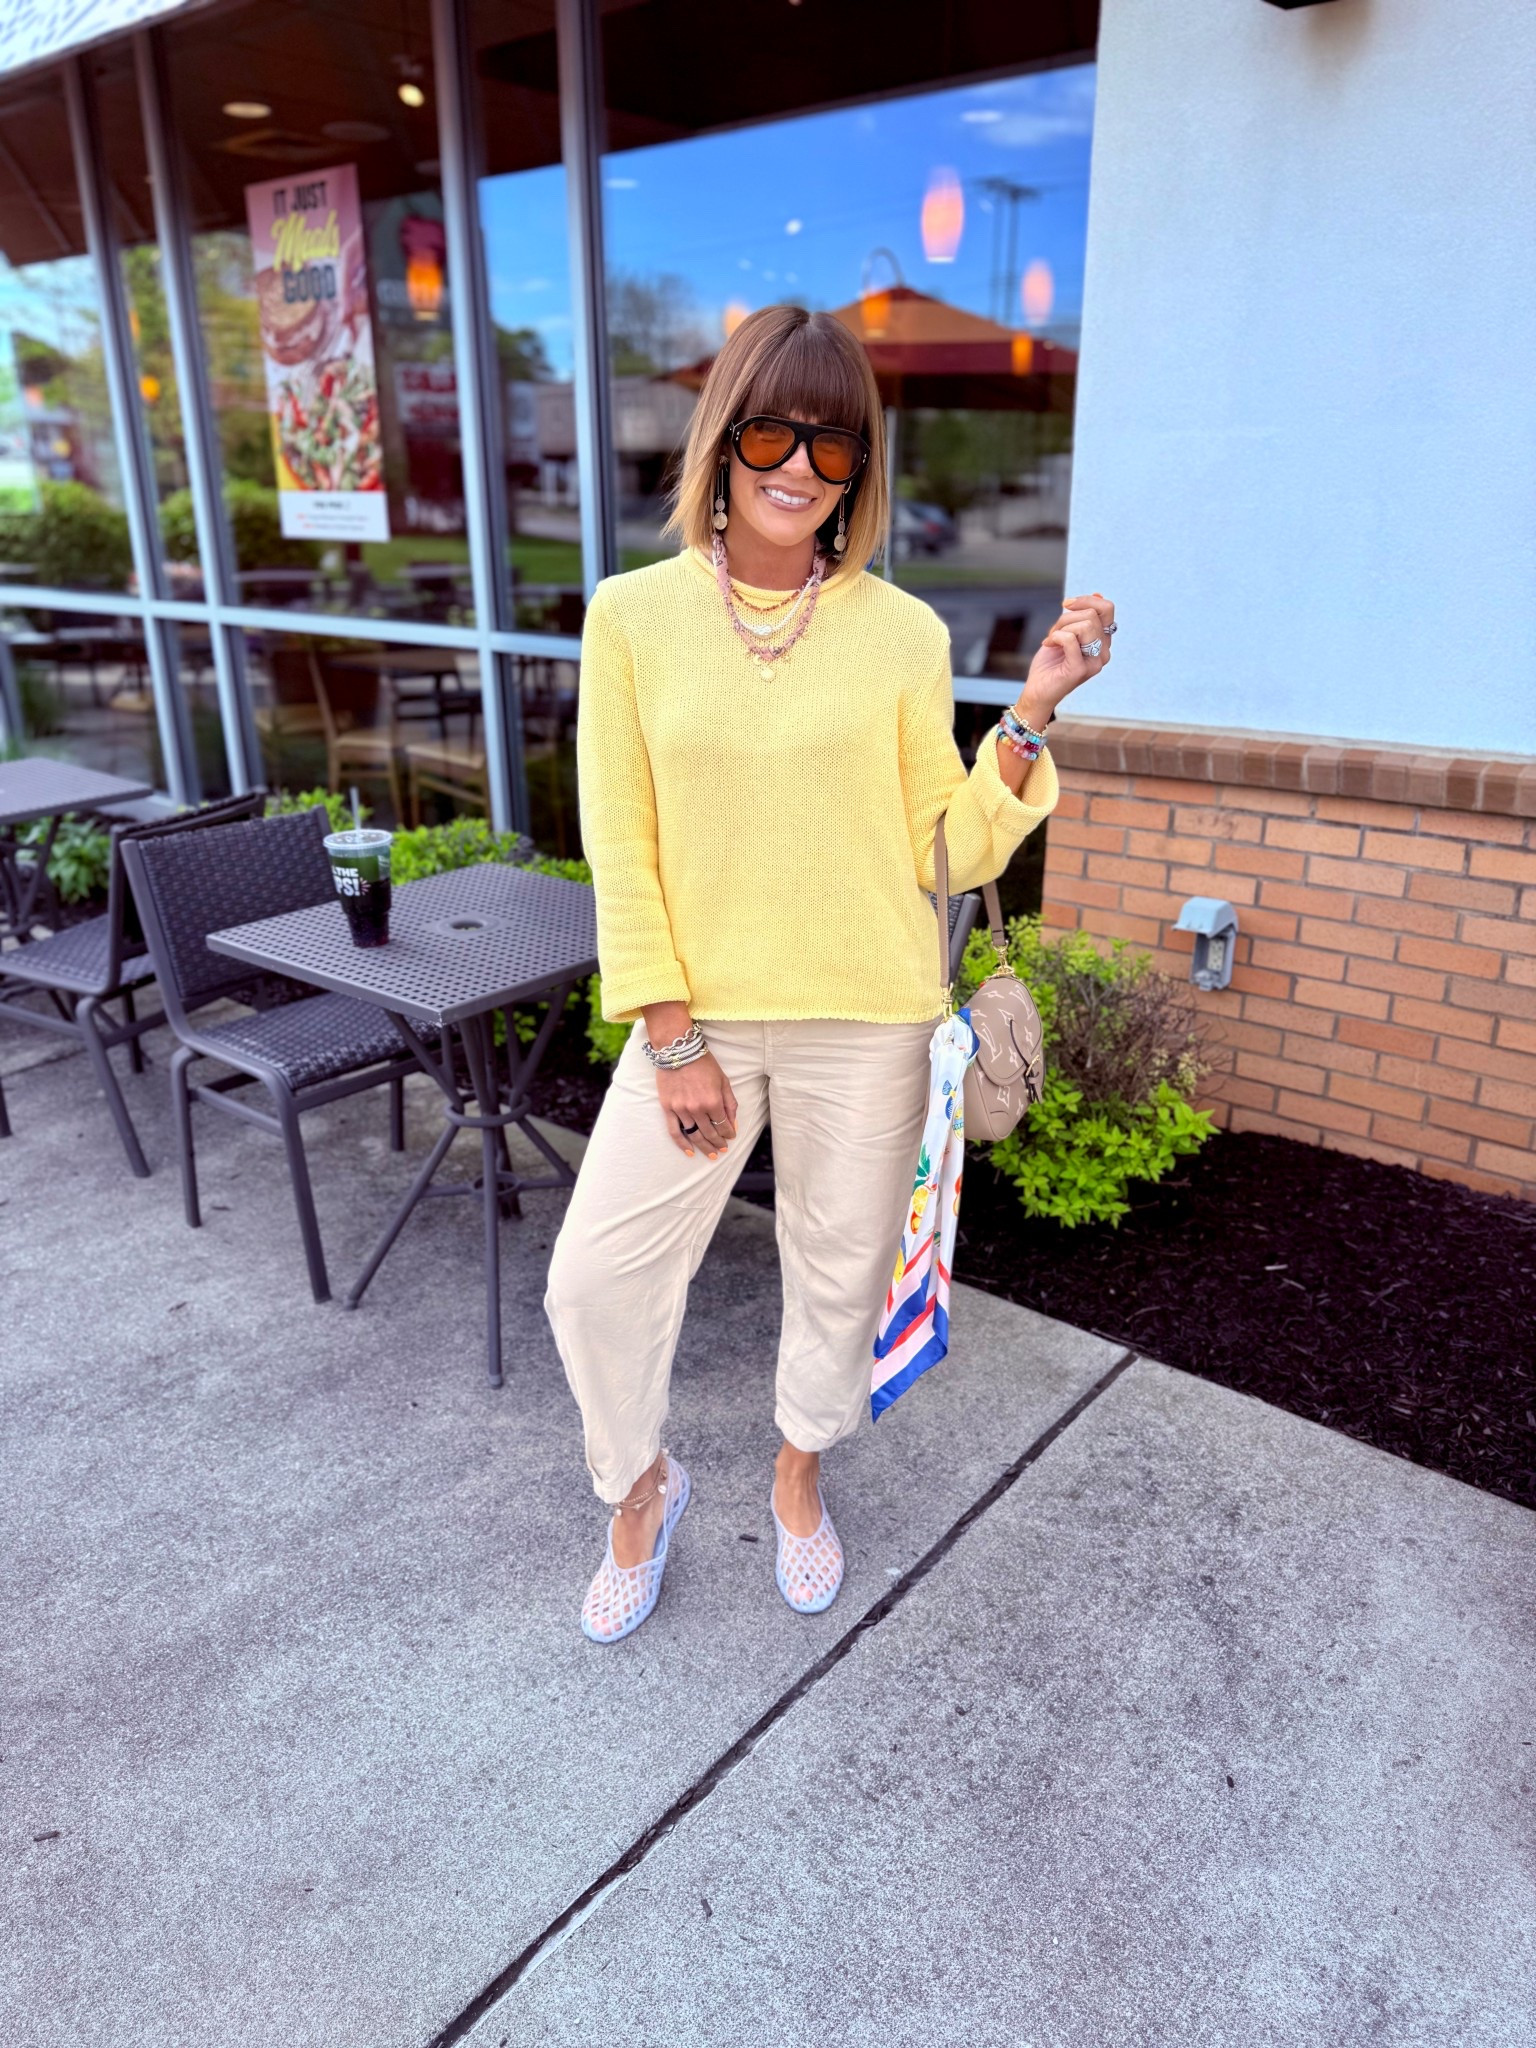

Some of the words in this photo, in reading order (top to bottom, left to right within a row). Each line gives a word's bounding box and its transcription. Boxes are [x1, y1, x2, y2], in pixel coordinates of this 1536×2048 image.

[273, 188, 286, 217] IT
[291, 181, 327, 210] JUST
[269, 209, 339, 272] Meals
[283, 264, 336, 304] GOOD
[335, 866, 359, 878] THE
